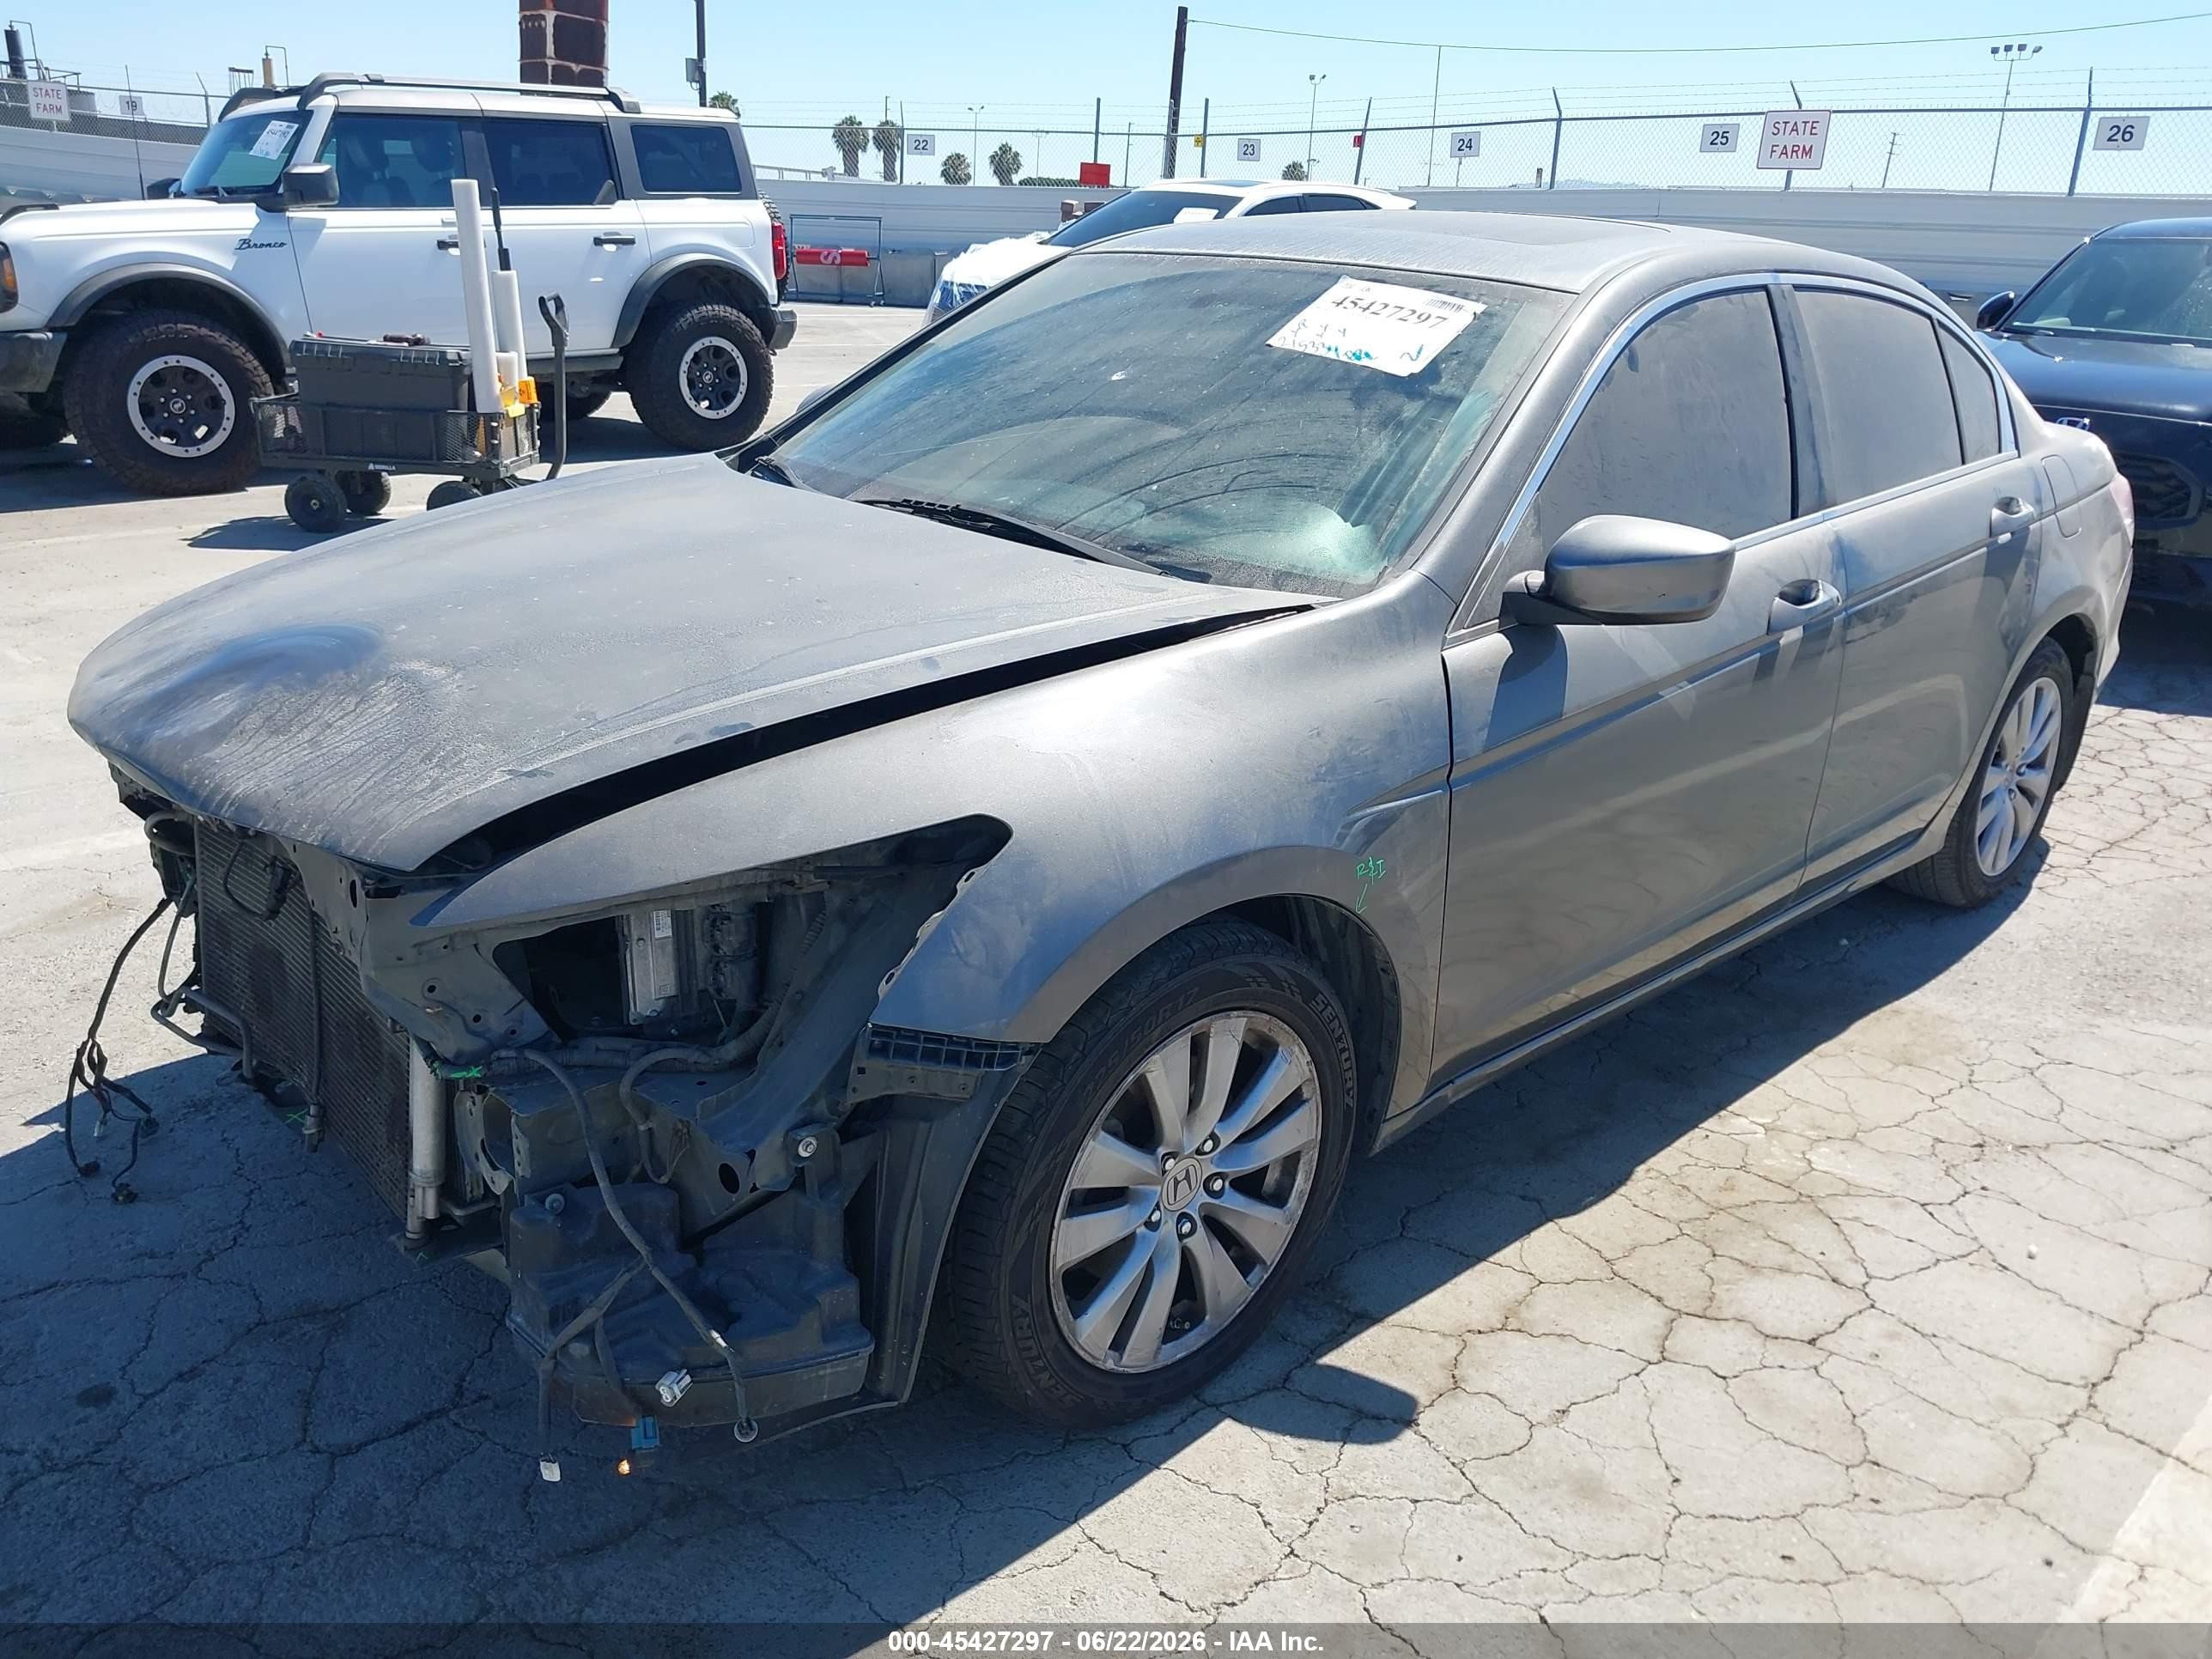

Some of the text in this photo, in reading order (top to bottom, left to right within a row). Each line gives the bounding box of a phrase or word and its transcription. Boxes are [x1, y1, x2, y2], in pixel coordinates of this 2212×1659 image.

[33, 88, 63, 100] STATE
[36, 102, 63, 115] FARM
[1771, 120, 1820, 137] STATE
[2106, 124, 2136, 143] 26
[914, 138, 929, 151] 22
[1457, 137, 1474, 152] 24
[1710, 131, 1729, 146] 25
[1243, 143, 1255, 156] 23
[1769, 143, 1814, 160] FARM
[234, 238, 288, 251] Bronco
[1331, 295, 1449, 329] 45427297
